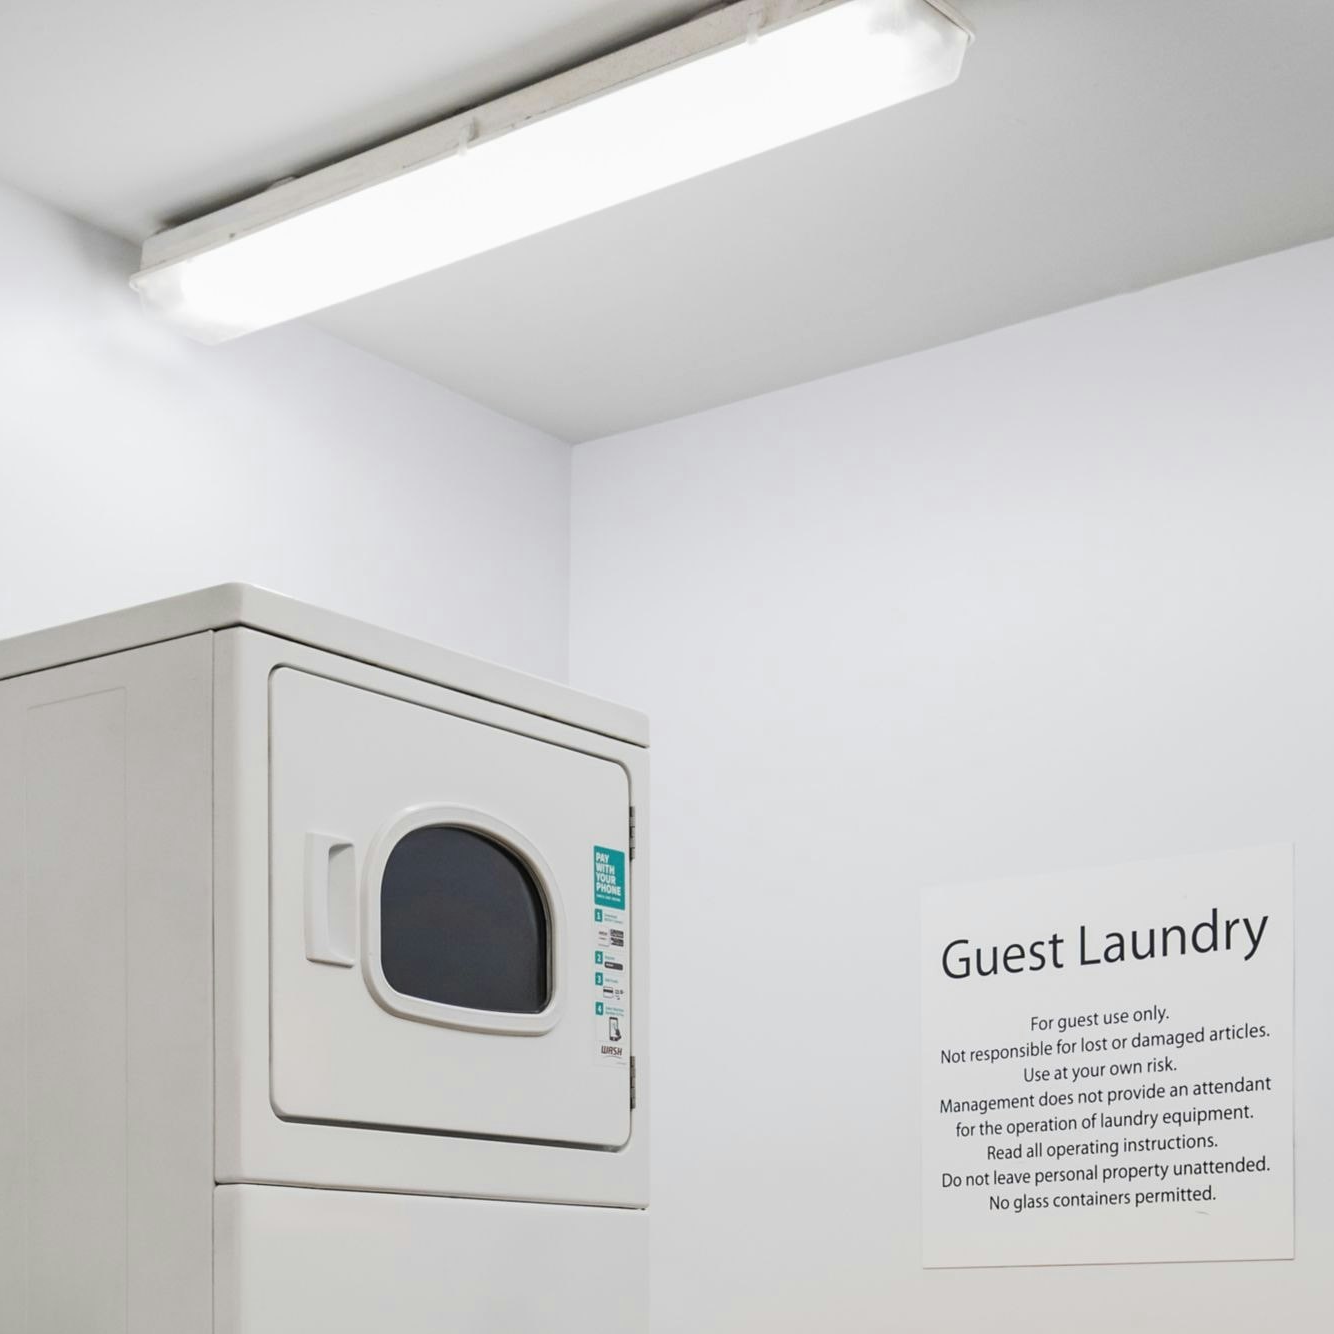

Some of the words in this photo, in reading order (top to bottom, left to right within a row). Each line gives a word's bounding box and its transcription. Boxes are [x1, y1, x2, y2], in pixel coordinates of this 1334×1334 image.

[596, 852, 609, 863] PAY
[596, 862, 615, 875] WITH
[596, 872, 616, 884] YOUR
[596, 883, 621, 896] PHONE
[942, 933, 1065, 979] Guest
[1079, 907, 1269, 966] Laundry
[1031, 1016, 1054, 1031] For
[1057, 1012, 1099, 1033] guest
[1103, 1010, 1129, 1025] use
[1132, 1005, 1170, 1024] only.
[601, 1045, 622, 1056] WASH
[940, 1048, 966, 1064] Not
[970, 1041, 1053, 1064] responsible
[1057, 1038, 1077, 1054] for
[1081, 1037, 1108, 1054] lost
[1111, 1036, 1128, 1050] or
[1131, 1028, 1205, 1050] damaged
[1209, 1023, 1270, 1043] articles.
[1024, 1067, 1050, 1082] Use
[1054, 1066, 1068, 1080] at
[1072, 1064, 1106, 1082] your
[1110, 1061, 1142, 1077] own
[1146, 1057, 1177, 1074] risk.
[940, 1093, 1035, 1116] Management
[1038, 1091, 1074, 1107] does
[1078, 1090, 1103, 1104] not
[1107, 1084, 1166, 1105] provide
[1170, 1083, 1189, 1098] an
[1193, 1077, 1272, 1096] attendant
[956, 1122, 975, 1138] for
[979, 1120, 1003, 1136] the
[1006, 1116, 1078, 1137] operation
[1081, 1114, 1096, 1130] of
[1100, 1110, 1158, 1131] laundry
[1162, 1105, 1254, 1125] equipment.
[987, 1144, 1022, 1160] Read
[1027, 1143, 1042, 1158] all
[1047, 1138, 1119, 1160] operating
[1123, 1132, 1218, 1153] instructions.
[942, 1173, 962, 1188] Do
[966, 1171, 989, 1186] not
[994, 1168, 1031, 1184] leave
[1035, 1165, 1098, 1186] personal
[1102, 1162, 1168, 1182] property
[1173, 1156, 1270, 1176] unattended.
[989, 1196, 1009, 1210] No
[1013, 1192, 1049, 1213] glass
[1053, 1189, 1131, 1208] containers
[1135, 1186, 1216, 1206] permitted.
